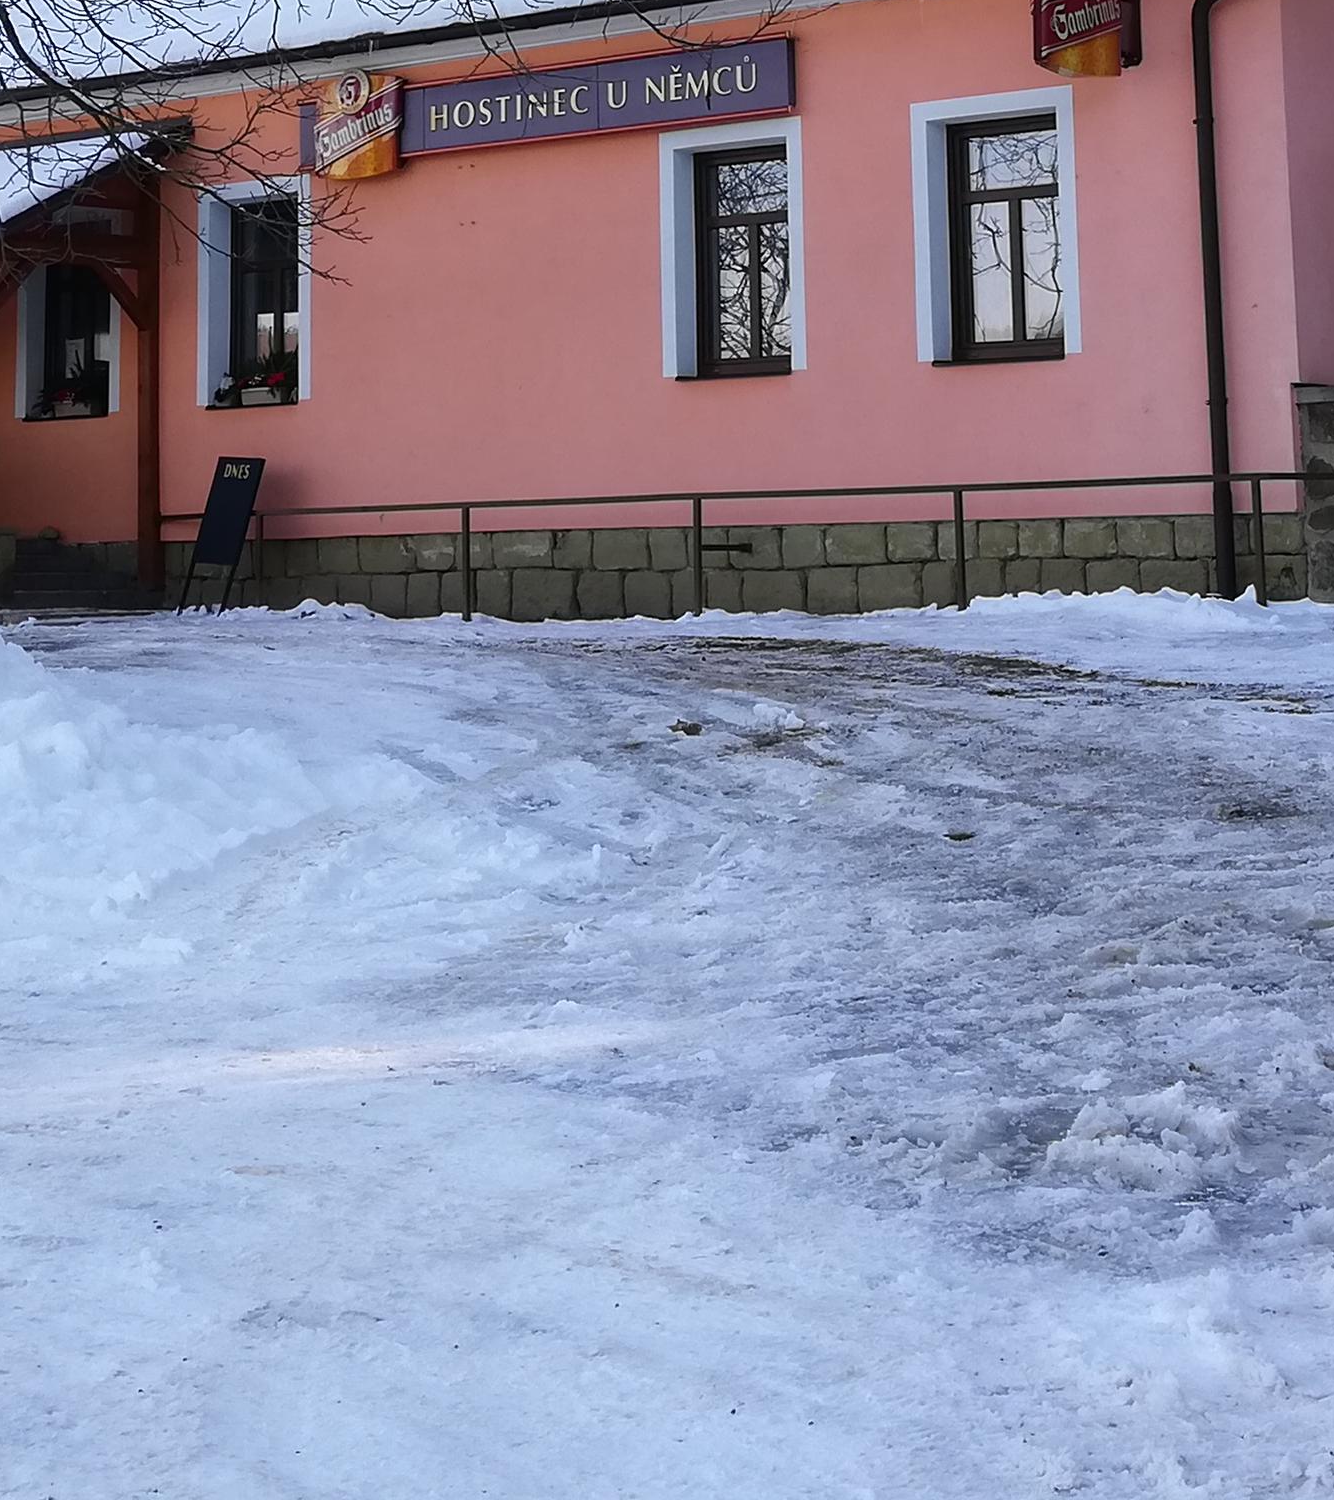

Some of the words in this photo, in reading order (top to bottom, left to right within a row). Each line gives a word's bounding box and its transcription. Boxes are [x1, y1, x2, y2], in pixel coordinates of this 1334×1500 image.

[429, 85, 589, 131] HOSTINEC
[606, 80, 628, 109] U
[645, 55, 757, 105] NĚMCŮ
[316, 103, 394, 158] Gambrinus
[223, 463, 251, 480] DNES
